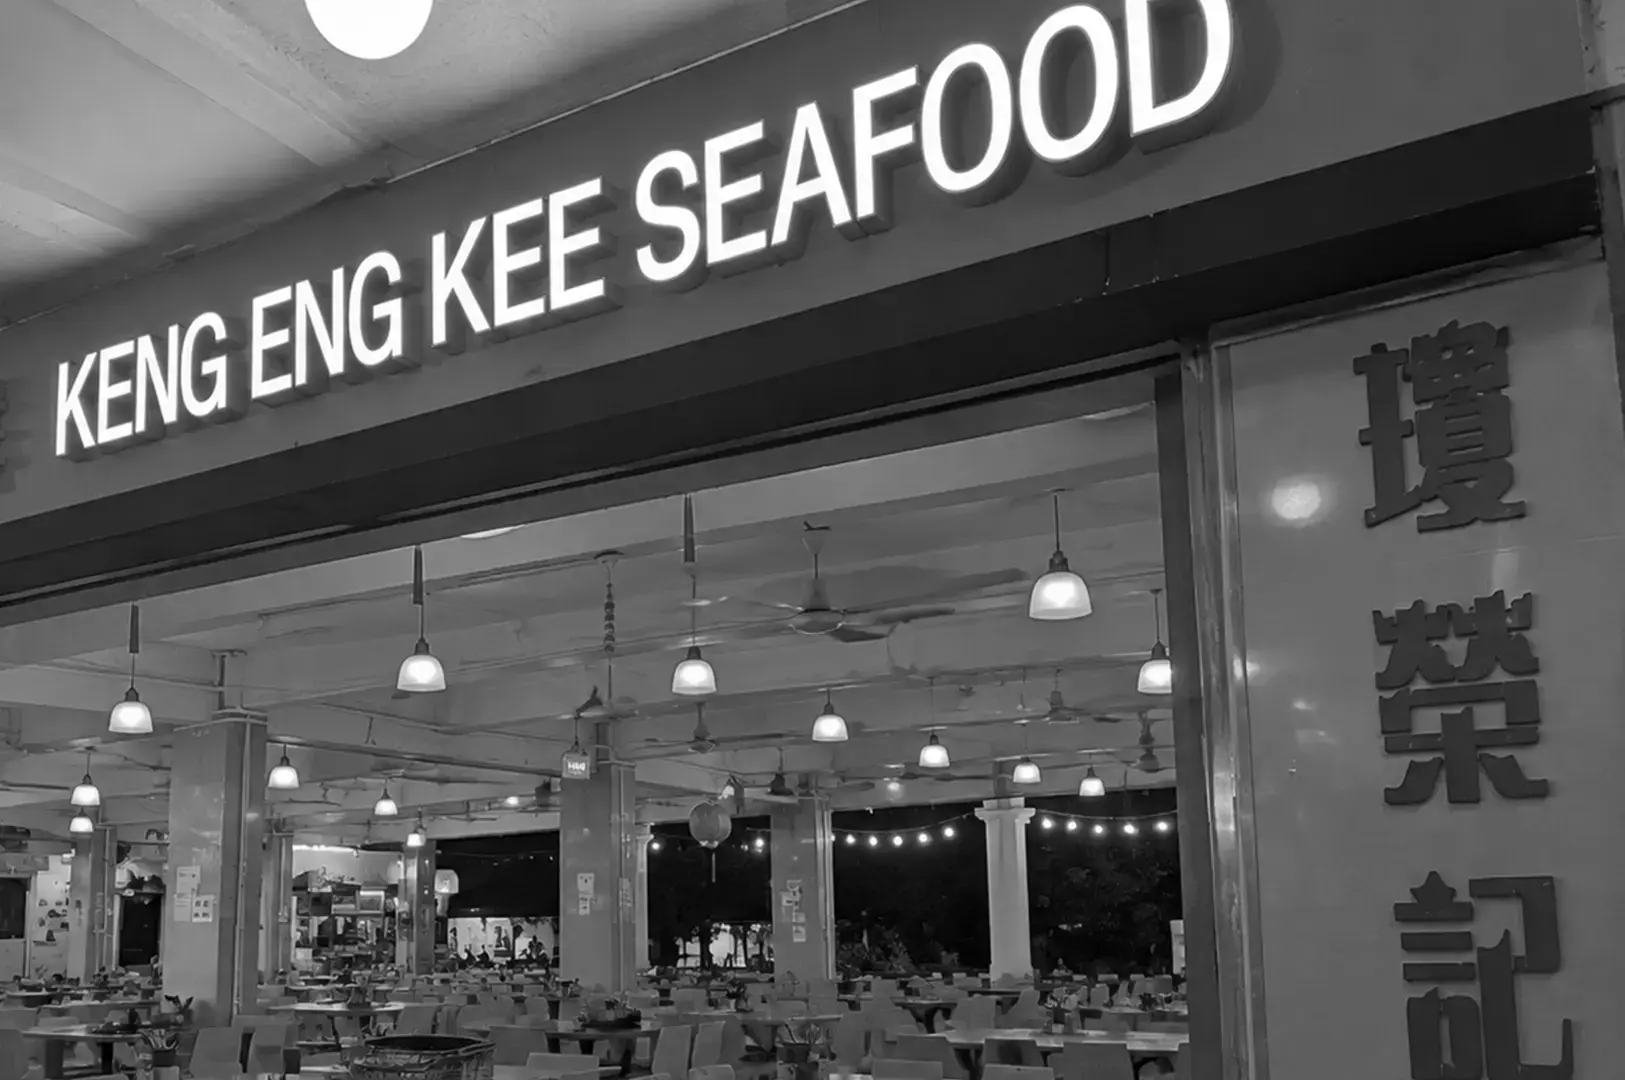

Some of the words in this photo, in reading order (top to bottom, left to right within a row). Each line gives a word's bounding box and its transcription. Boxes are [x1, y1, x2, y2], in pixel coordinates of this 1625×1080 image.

[56, 313, 226, 456] KENG
[251, 252, 402, 399] ENG
[432, 179, 604, 345] KEE
[636, 0, 1231, 281] SEAFOOD
